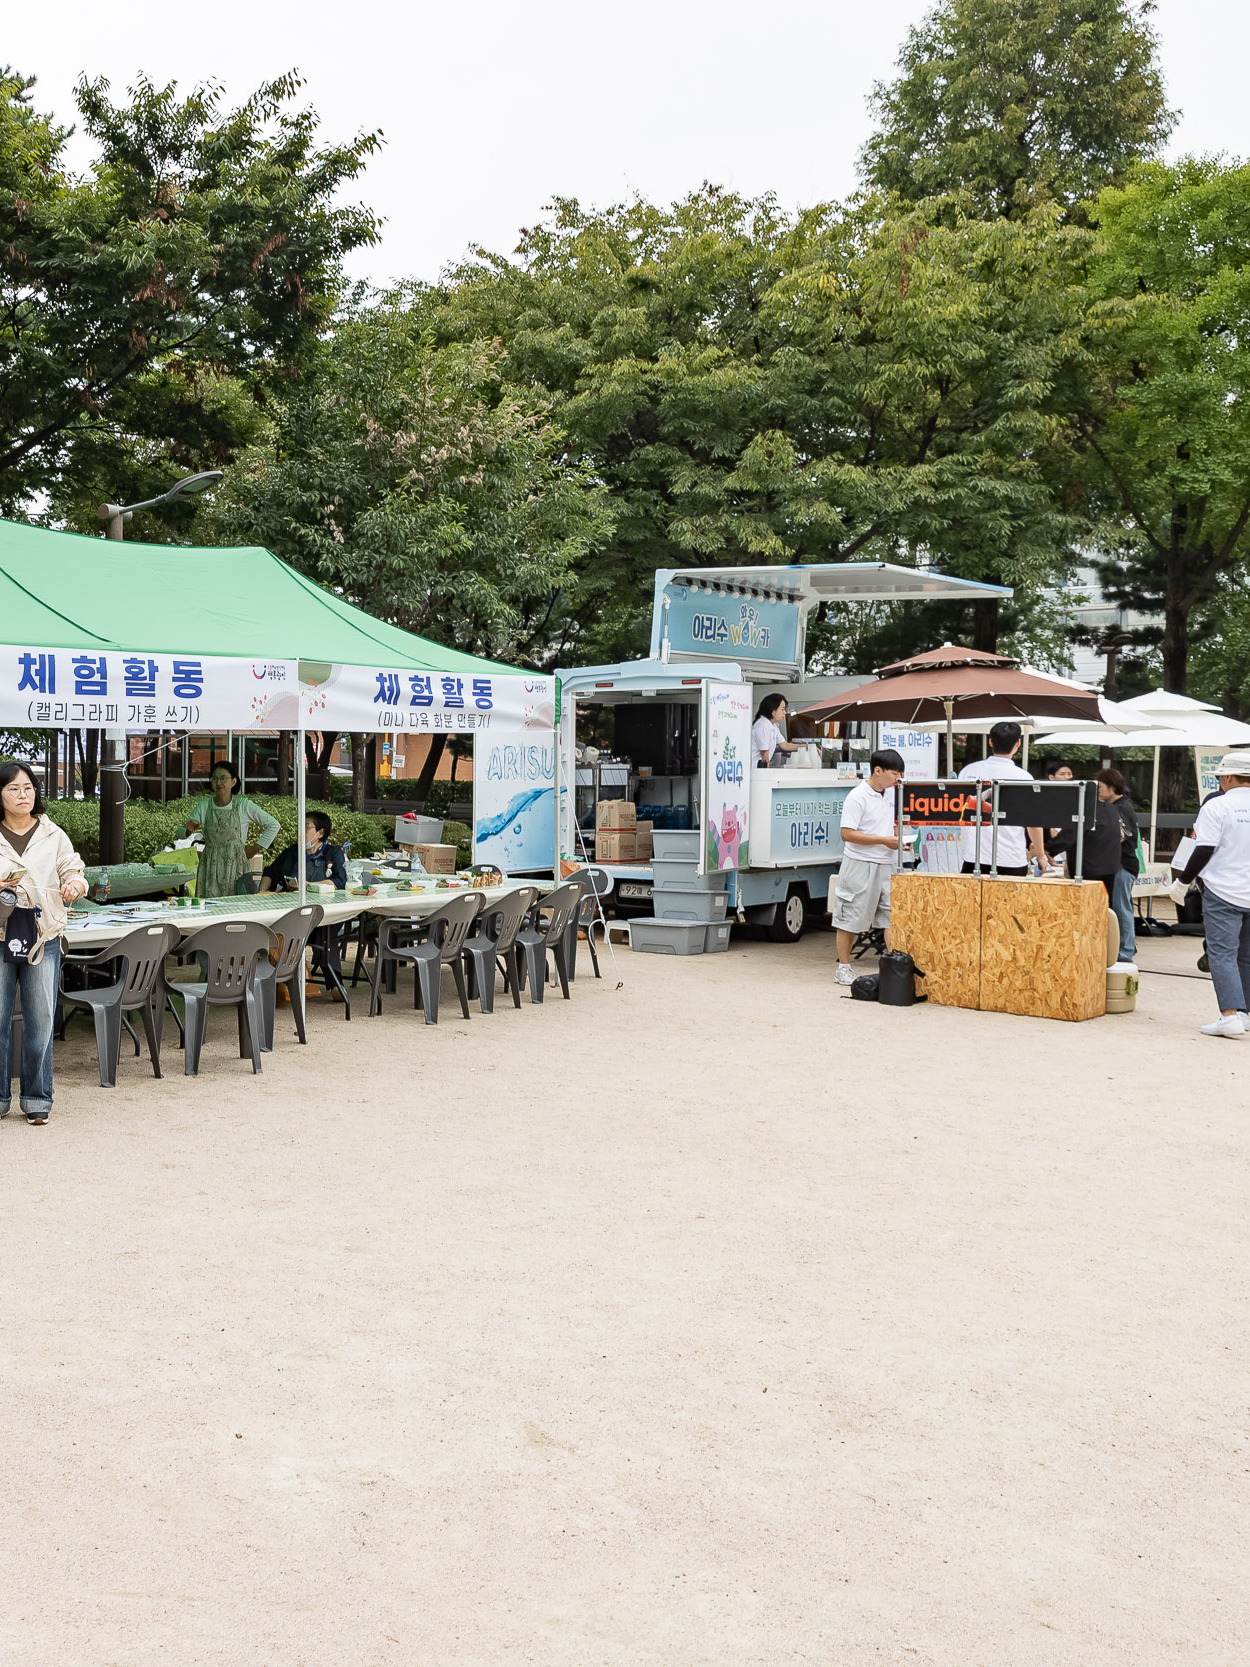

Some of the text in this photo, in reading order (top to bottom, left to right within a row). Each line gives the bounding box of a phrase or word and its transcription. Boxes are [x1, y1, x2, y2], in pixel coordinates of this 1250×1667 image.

[693, 615, 728, 643] 아리수
[17, 652, 205, 699] 체험활동
[374, 672, 494, 710] 체험활동
[27, 701, 201, 725] (캘리그라피 가훈 쓰기)
[377, 711, 491, 729] (미니 다육 화분 만들기)
[883, 734, 896, 748] 먹는
[908, 733, 932, 748] 아리수
[487, 743, 555, 781] ARISU
[716, 761, 743, 788] 아리수
[775, 803, 802, 817] 오늘부터
[804, 802, 817, 816] 내가
[819, 802, 830, 815] 먹는
[903, 793, 965, 816] iquid
[791, 821, 829, 848] 아리수!
